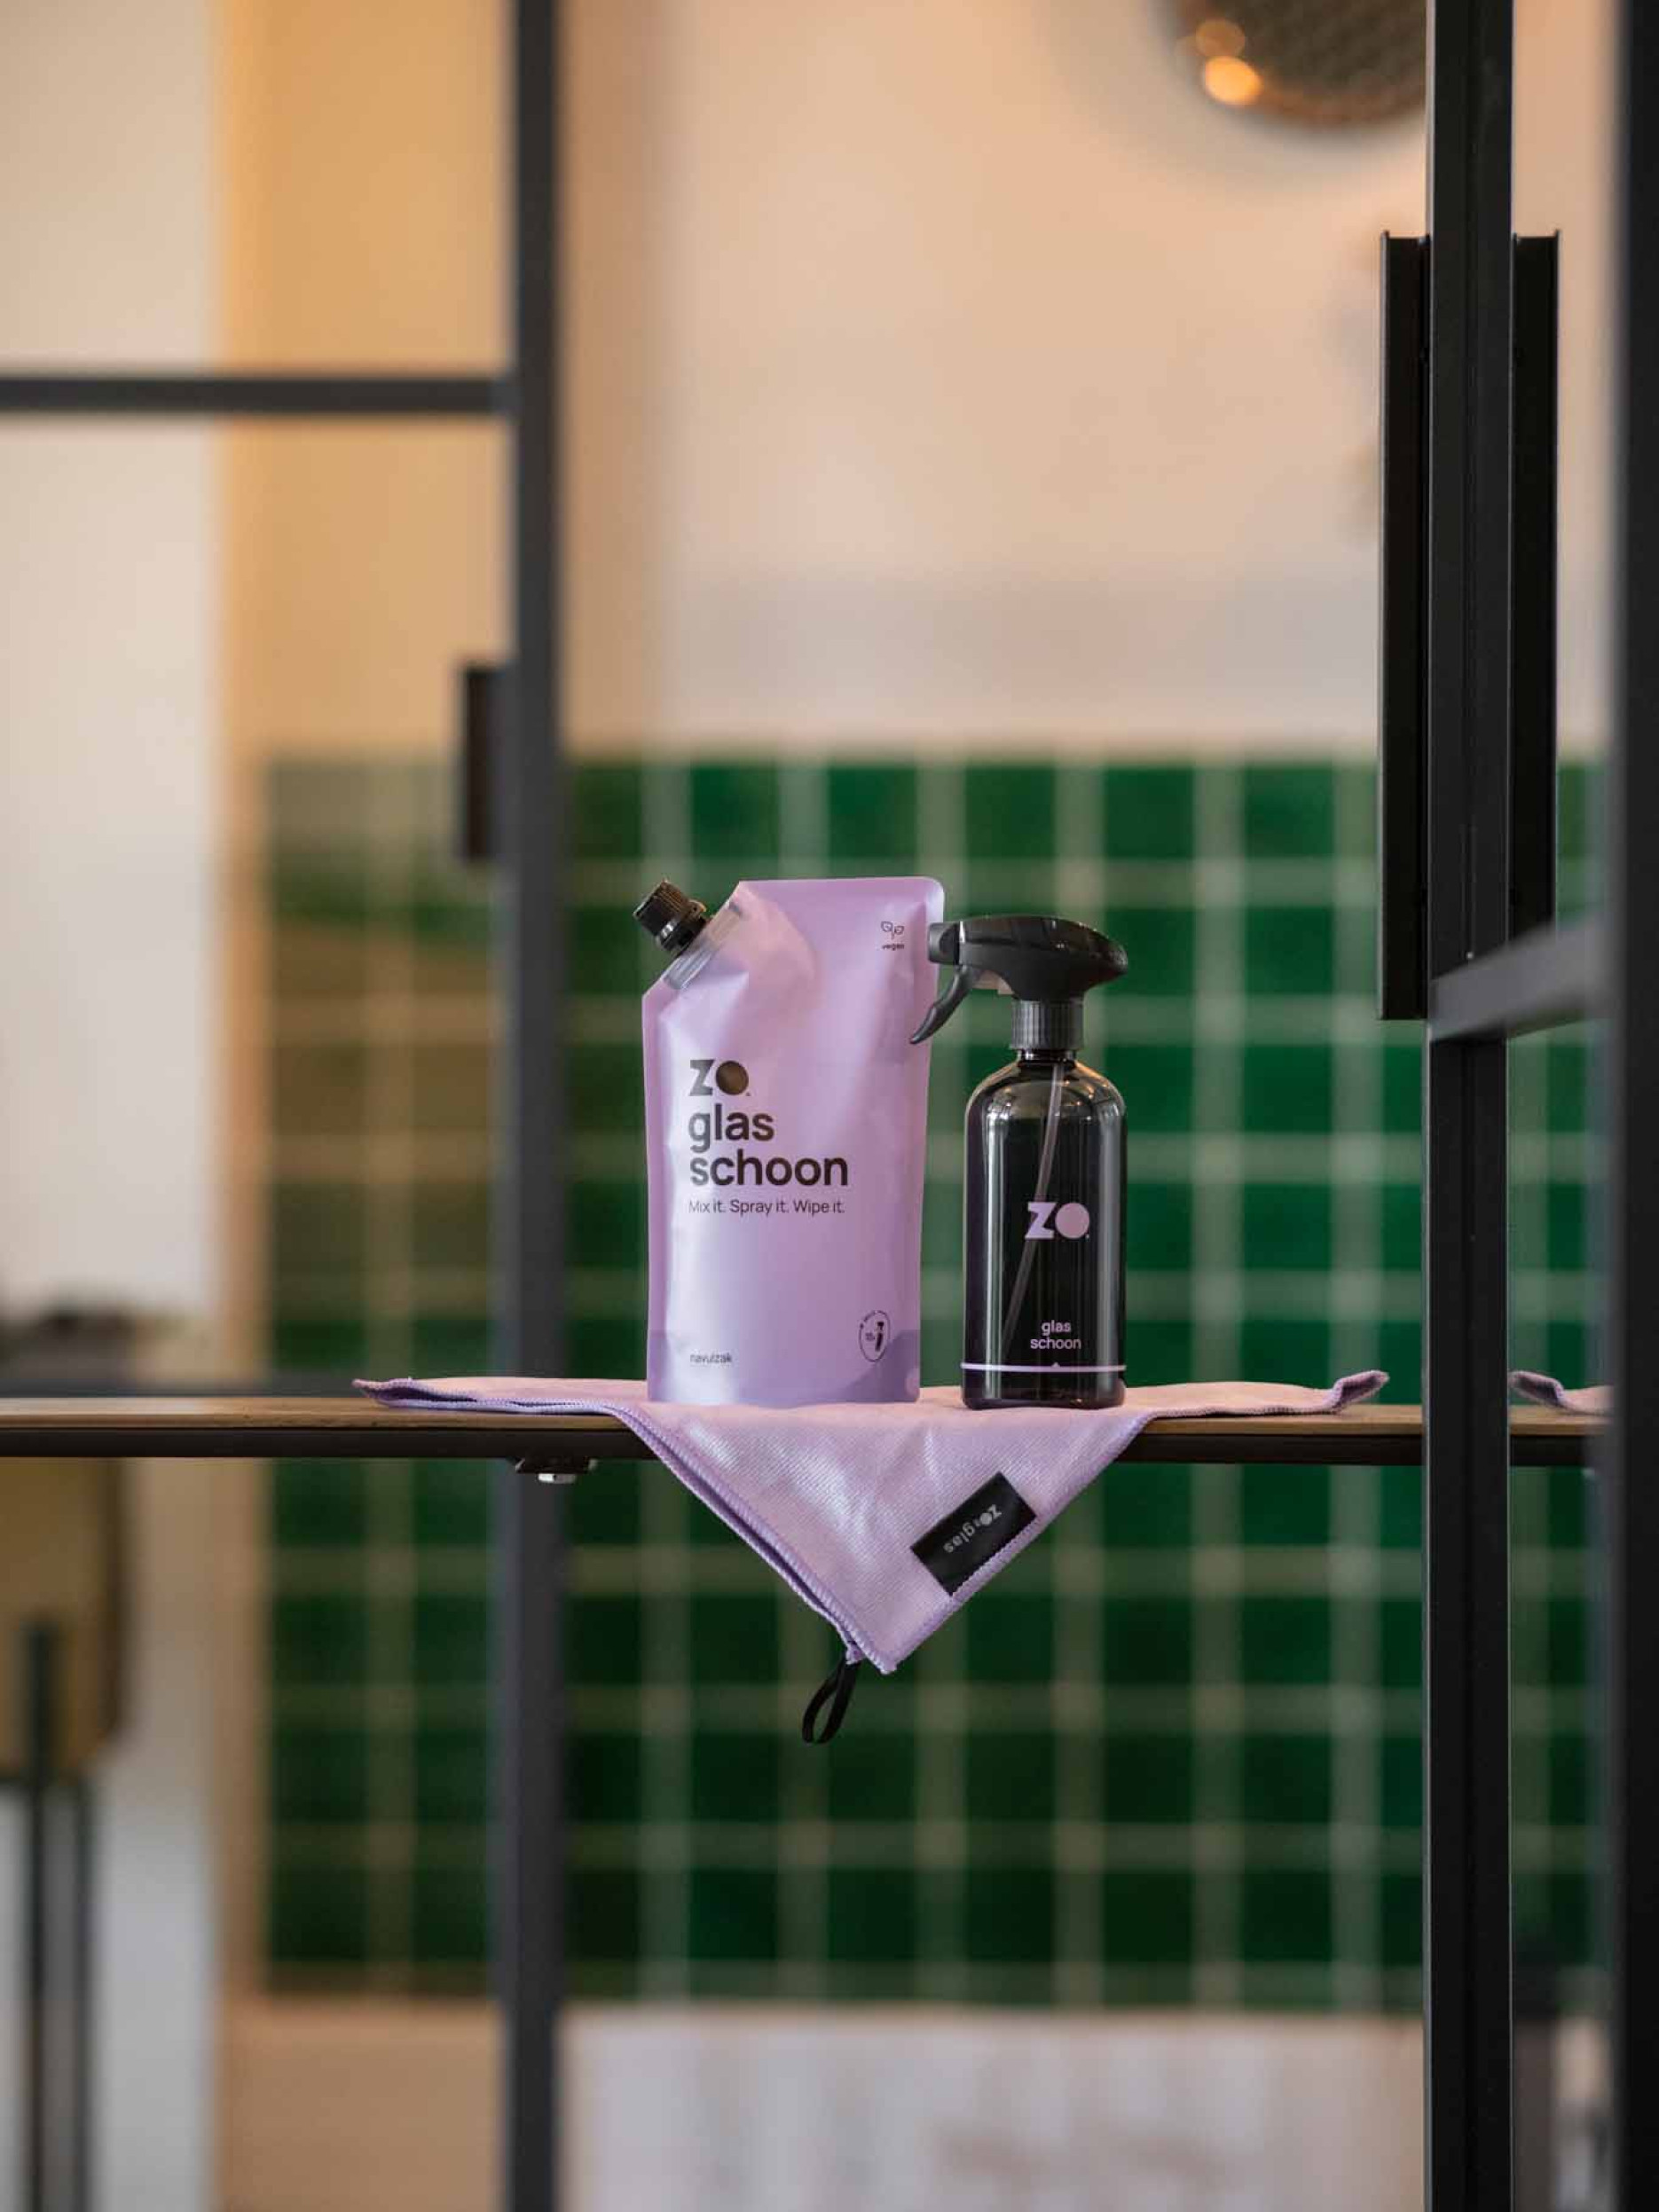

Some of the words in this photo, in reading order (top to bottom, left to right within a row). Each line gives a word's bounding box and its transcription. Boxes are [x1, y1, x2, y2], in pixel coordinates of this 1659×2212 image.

[688, 1102, 775, 1153] glas
[689, 1148, 849, 1186] schoon
[688, 1199, 710, 1213] Mix
[729, 1198, 772, 1215] Spray
[775, 1199, 790, 1213] it.
[793, 1199, 830, 1216] Wipe
[833, 1199, 845, 1213] it.
[1041, 1319, 1072, 1337] glas
[1030, 1336, 1081, 1350] schoon
